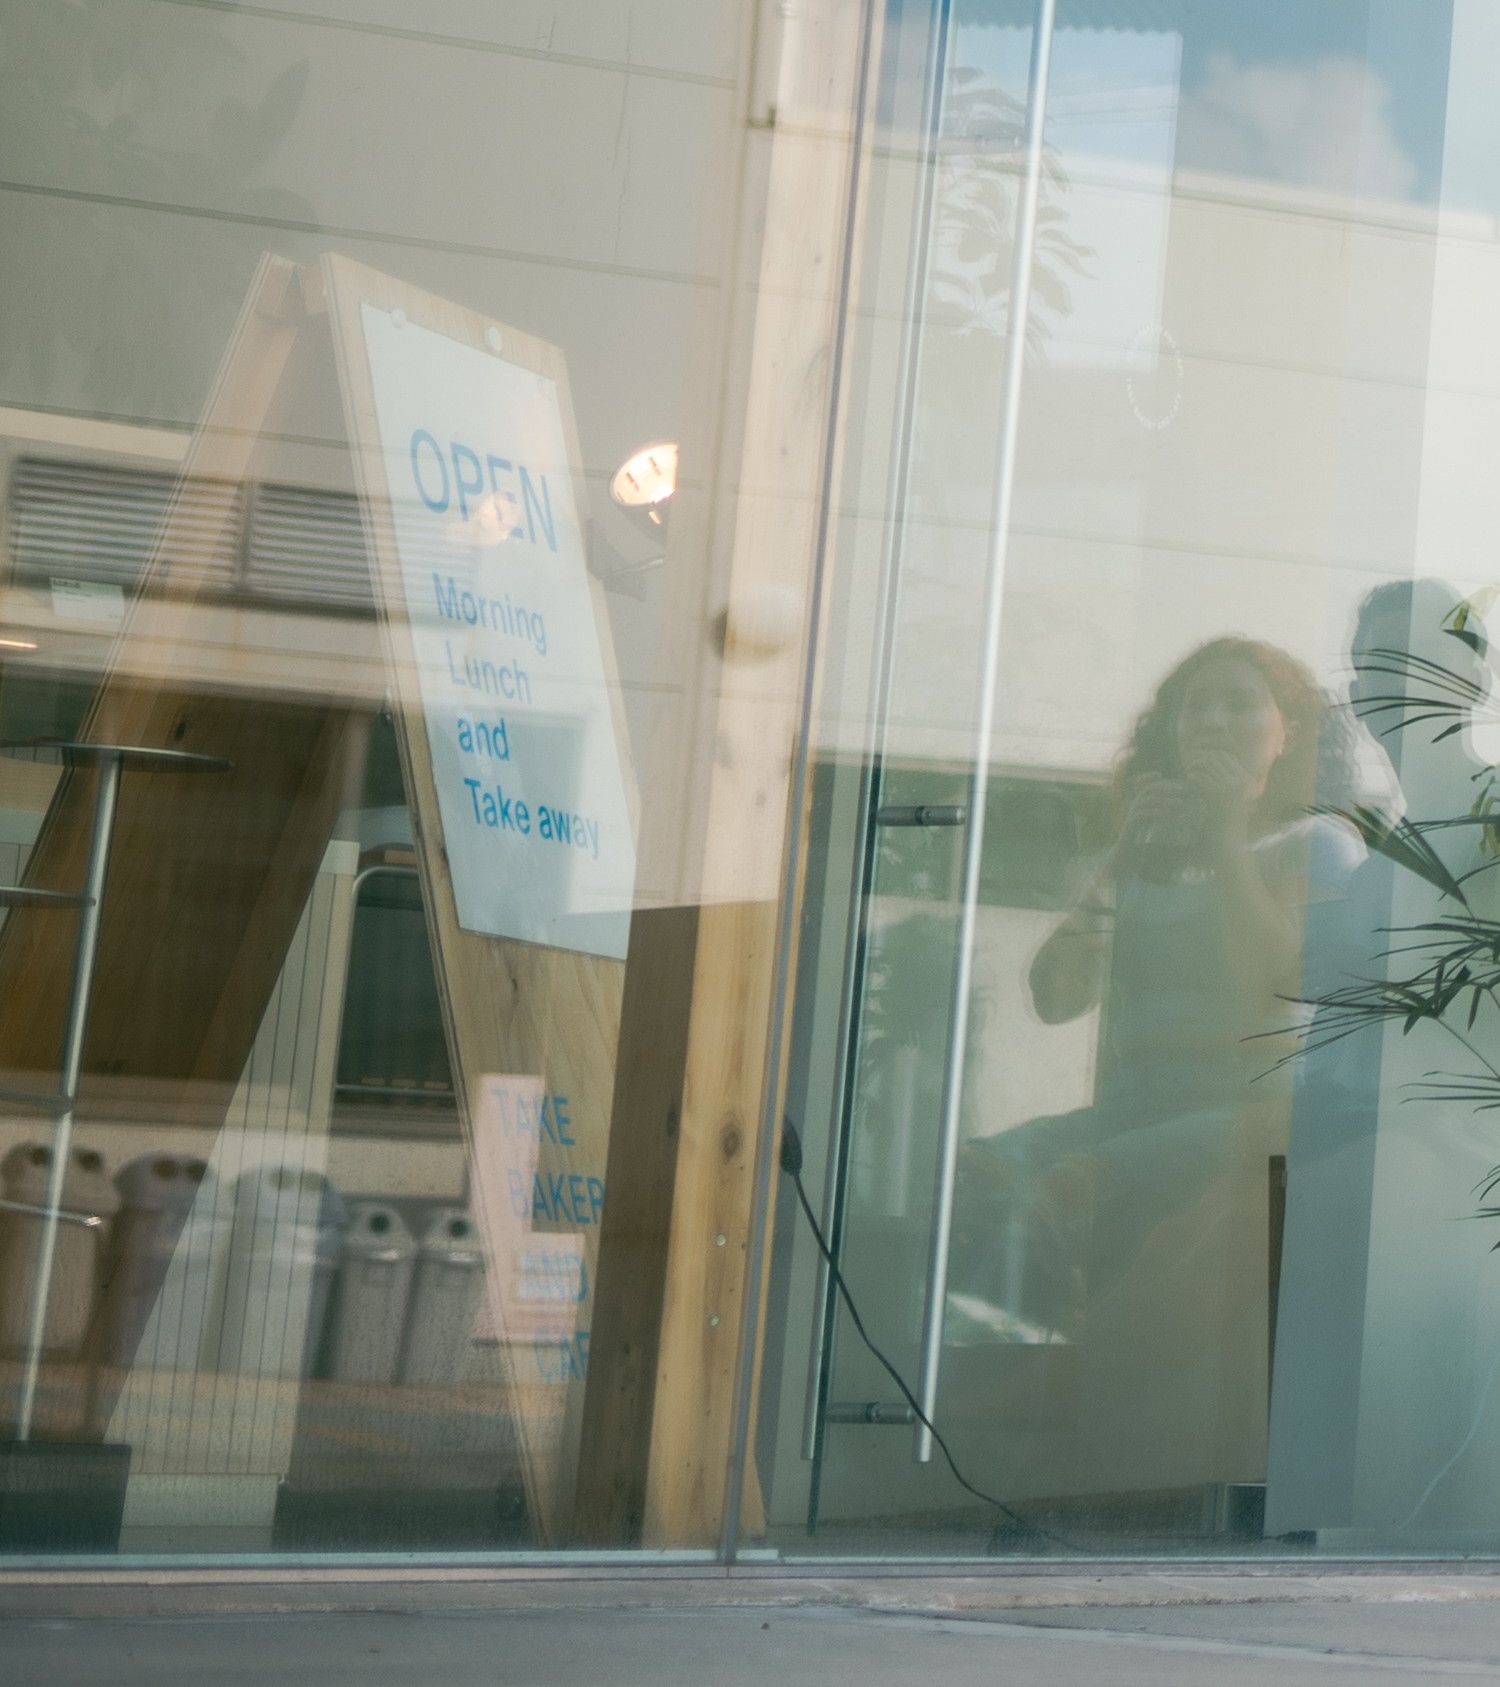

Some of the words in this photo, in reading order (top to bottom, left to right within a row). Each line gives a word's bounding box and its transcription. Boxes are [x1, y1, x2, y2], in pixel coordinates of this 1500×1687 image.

[410, 428, 559, 553] OPEN
[432, 572, 548, 657] Morning
[445, 639, 532, 705] Lunch
[457, 716, 511, 762] and
[463, 776, 532, 835] Take
[538, 804, 600, 861] away
[494, 1089, 575, 1146] TAKE
[508, 1169, 605, 1224] BAKER
[525, 1250, 589, 1302] AND
[534, 1327, 592, 1382] CAF
